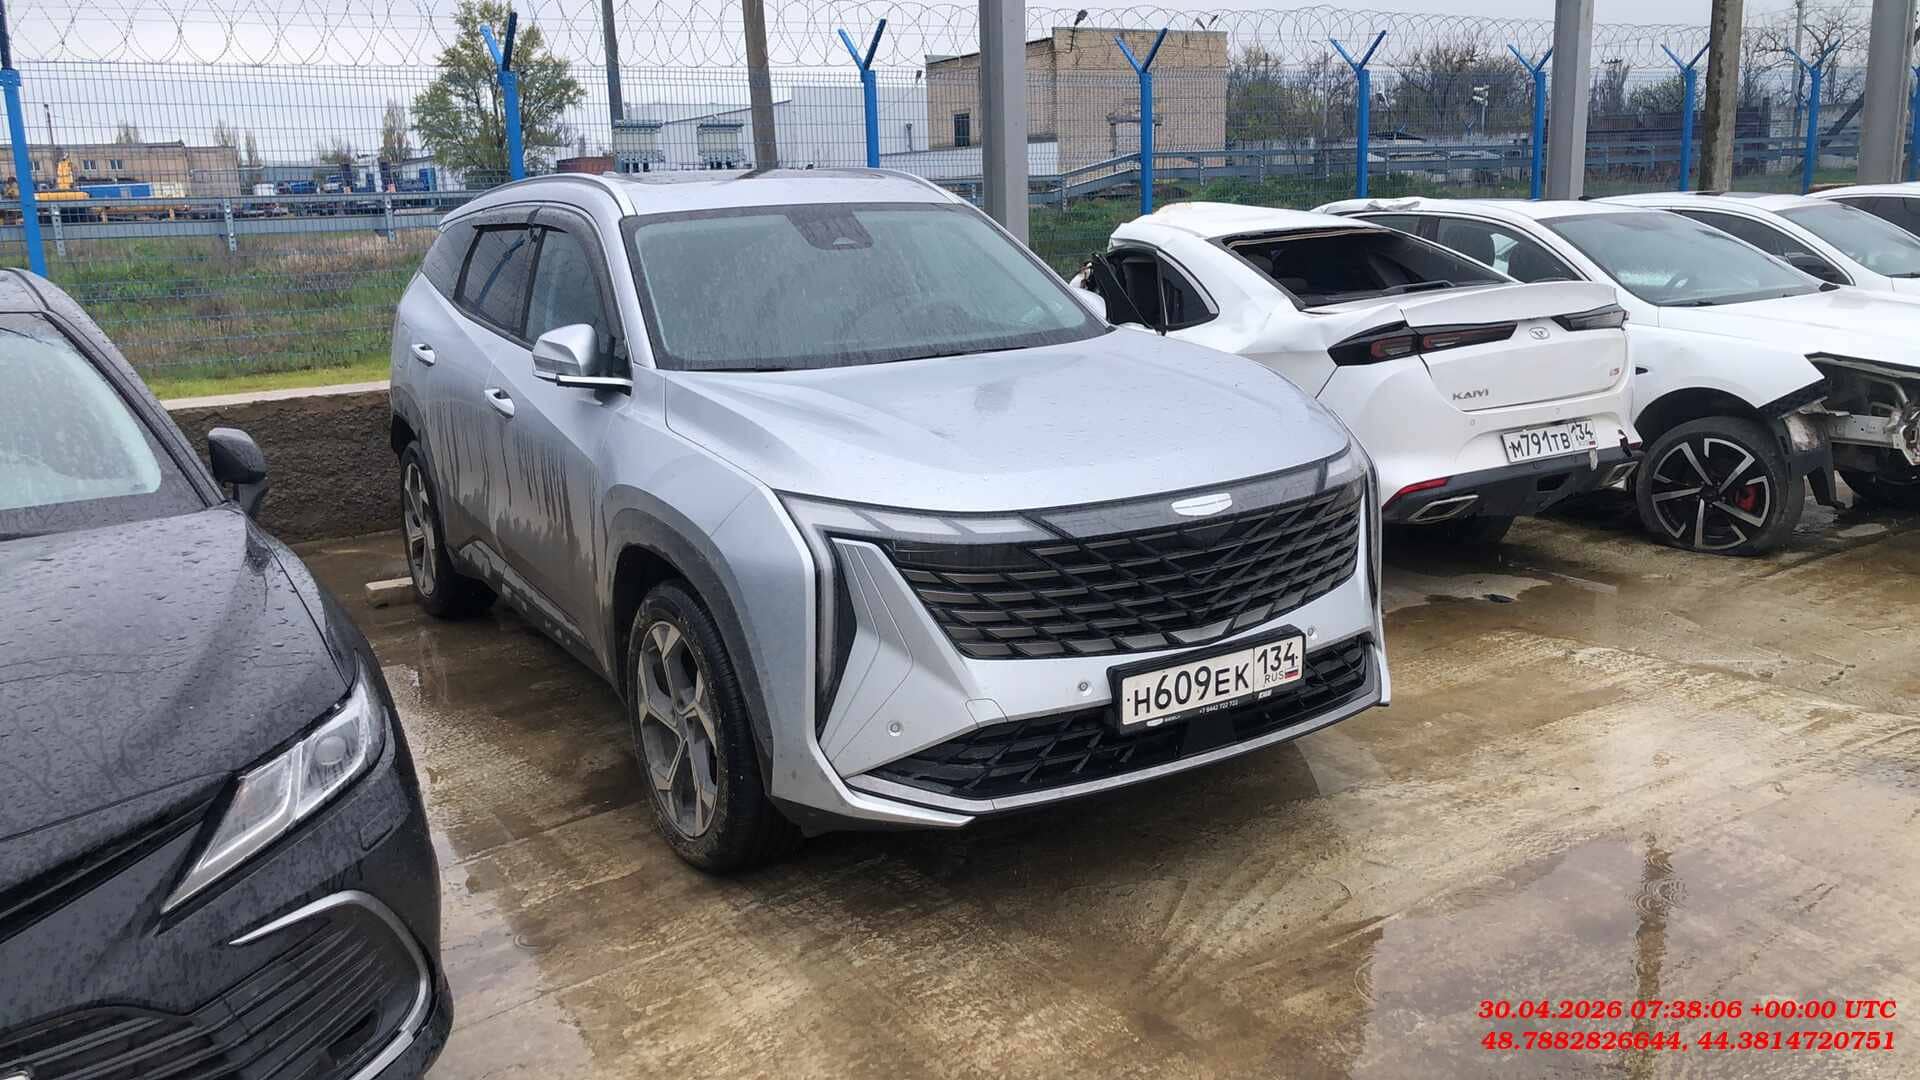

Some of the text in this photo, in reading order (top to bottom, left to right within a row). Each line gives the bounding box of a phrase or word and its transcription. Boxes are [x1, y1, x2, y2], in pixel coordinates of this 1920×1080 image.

[1452, 387, 1489, 401] KAIYI
[1511, 430, 1571, 458] М791ТВ
[1134, 641, 1296, 717] Н609ЕК 134
[1264, 671, 1285, 684] RUS
